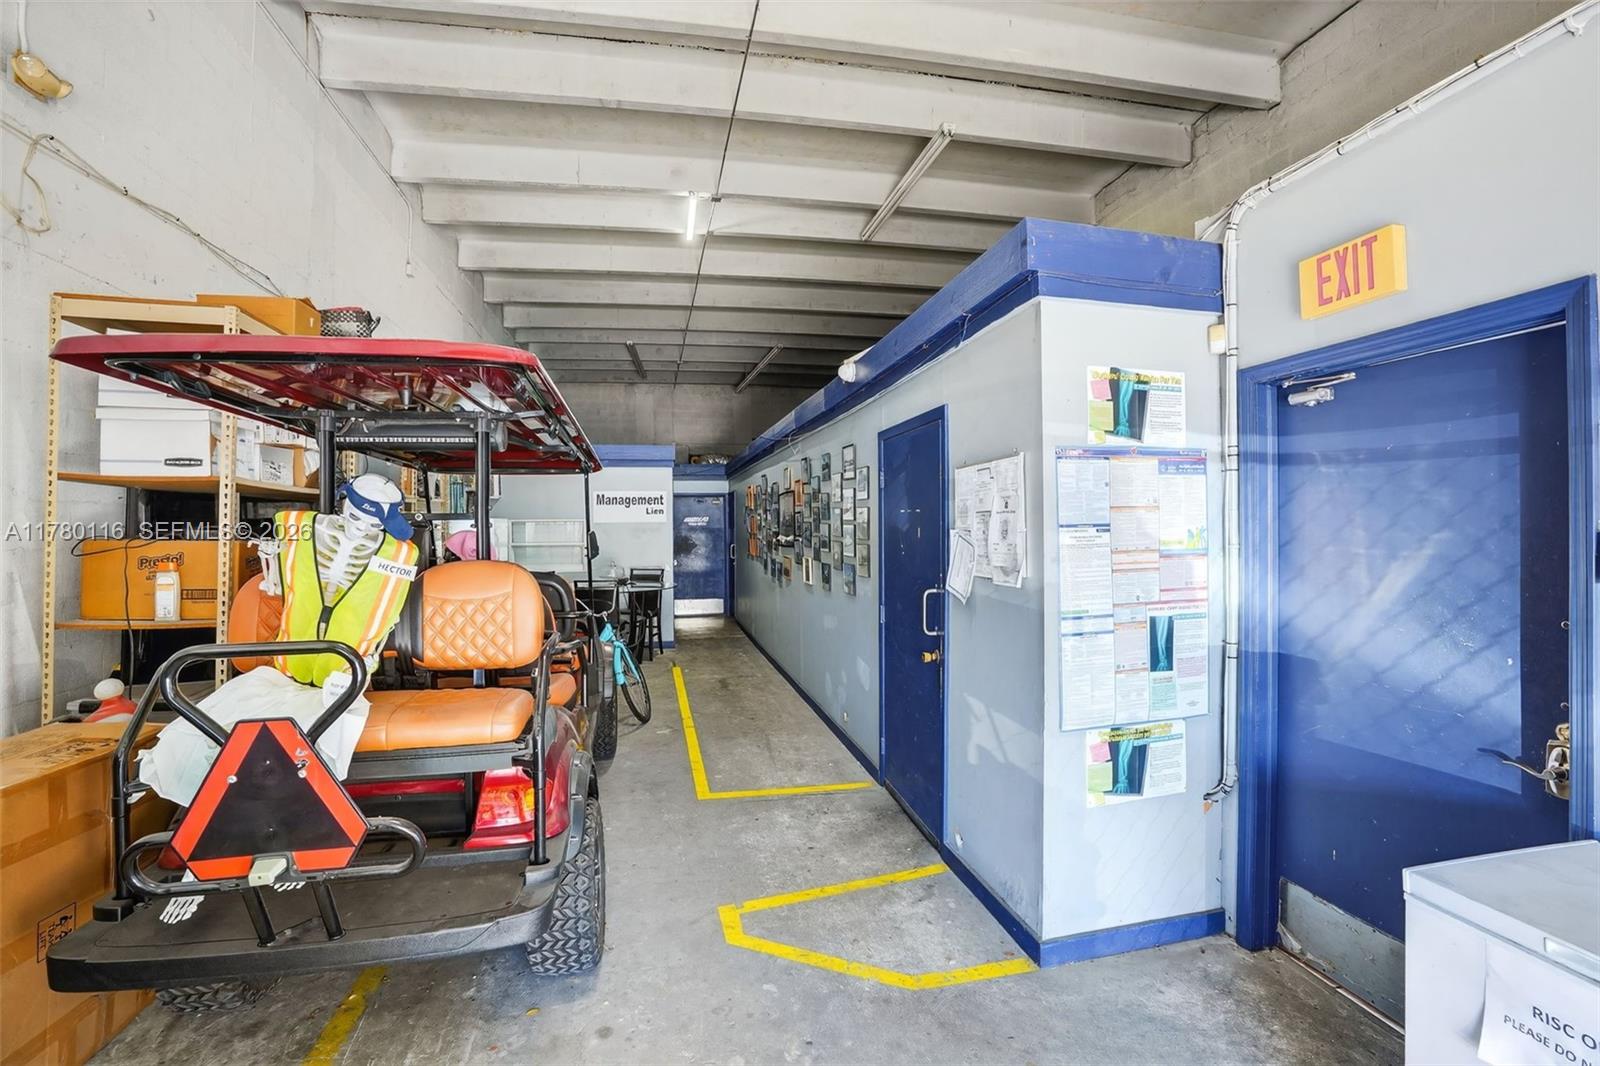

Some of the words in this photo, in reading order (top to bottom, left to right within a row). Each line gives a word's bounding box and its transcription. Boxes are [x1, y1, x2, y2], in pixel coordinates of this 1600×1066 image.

[1316, 234, 1378, 307] EXIT
[596, 493, 664, 509] Management
[646, 507, 664, 515] Lien
[138, 552, 184, 570] Presto!
[378, 562, 413, 577] HECTOR
[1532, 1006, 1575, 1039] RISC
[1581, 1033, 1600, 1051] O
[1503, 1014, 1551, 1048] PLEASE
[1554, 1043, 1577, 1062] DO
